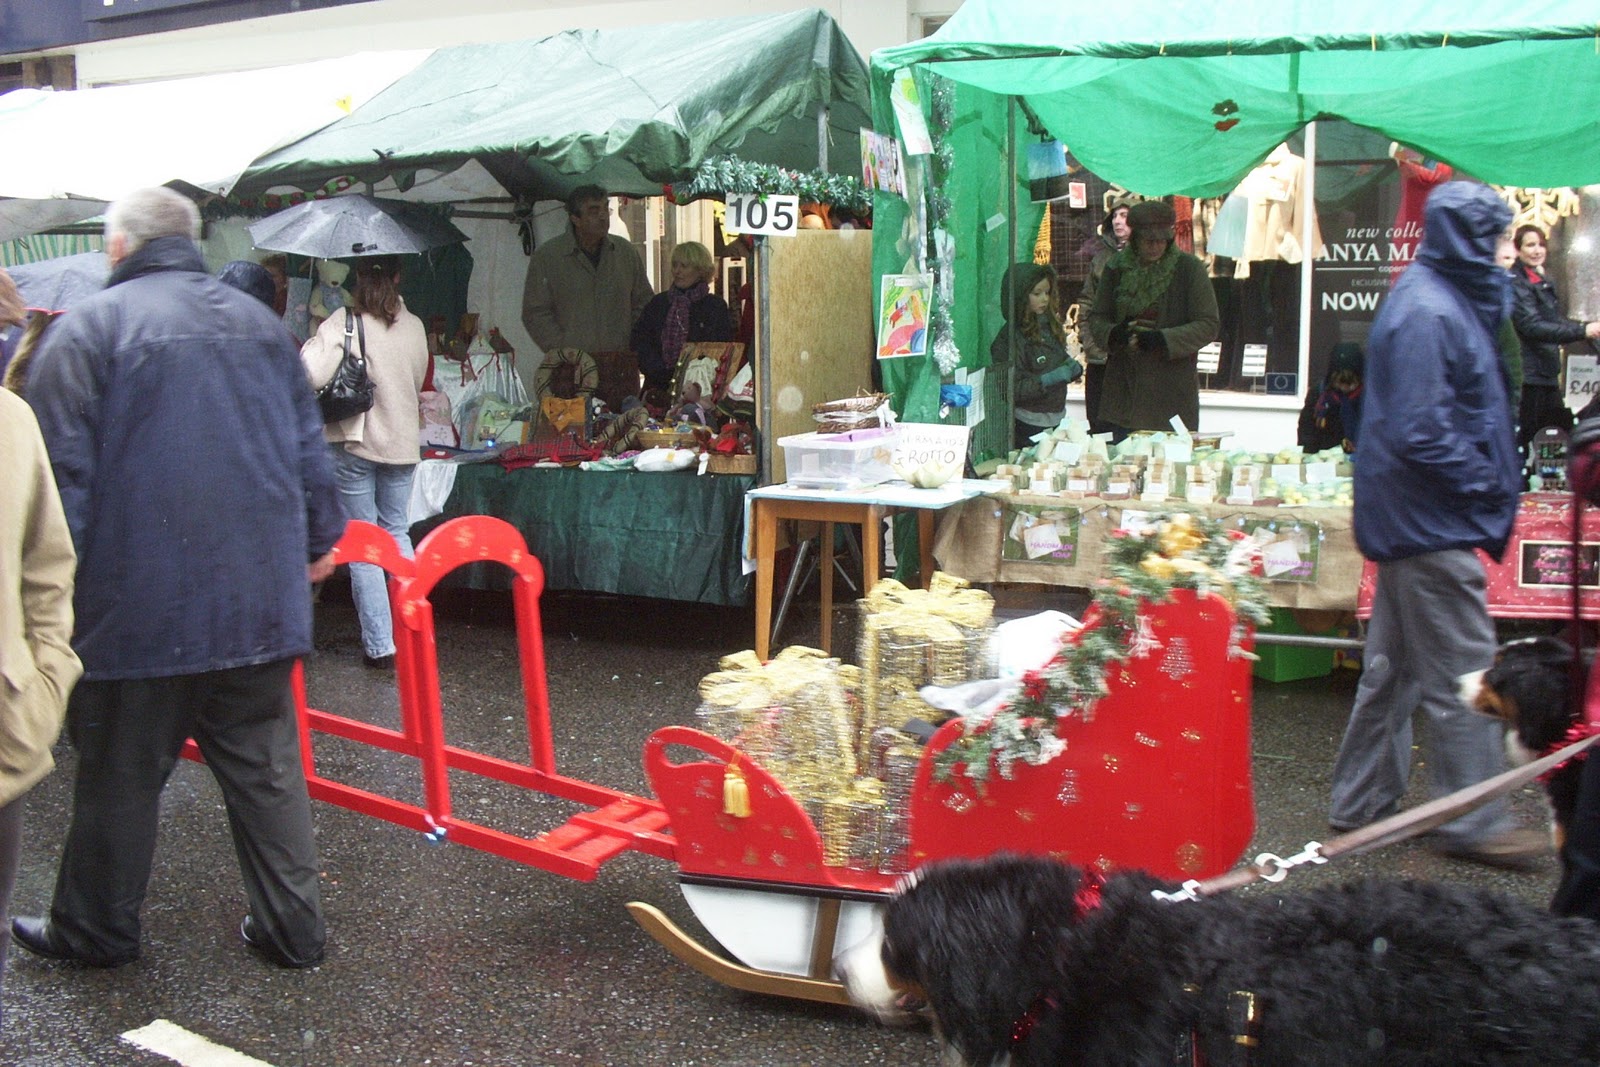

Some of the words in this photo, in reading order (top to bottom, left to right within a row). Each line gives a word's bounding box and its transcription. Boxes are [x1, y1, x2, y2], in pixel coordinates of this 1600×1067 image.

[729, 198, 793, 231] 105
[1346, 227, 1380, 238] new
[1315, 243, 1381, 261] ANYA
[1322, 292, 1380, 311] NOW
